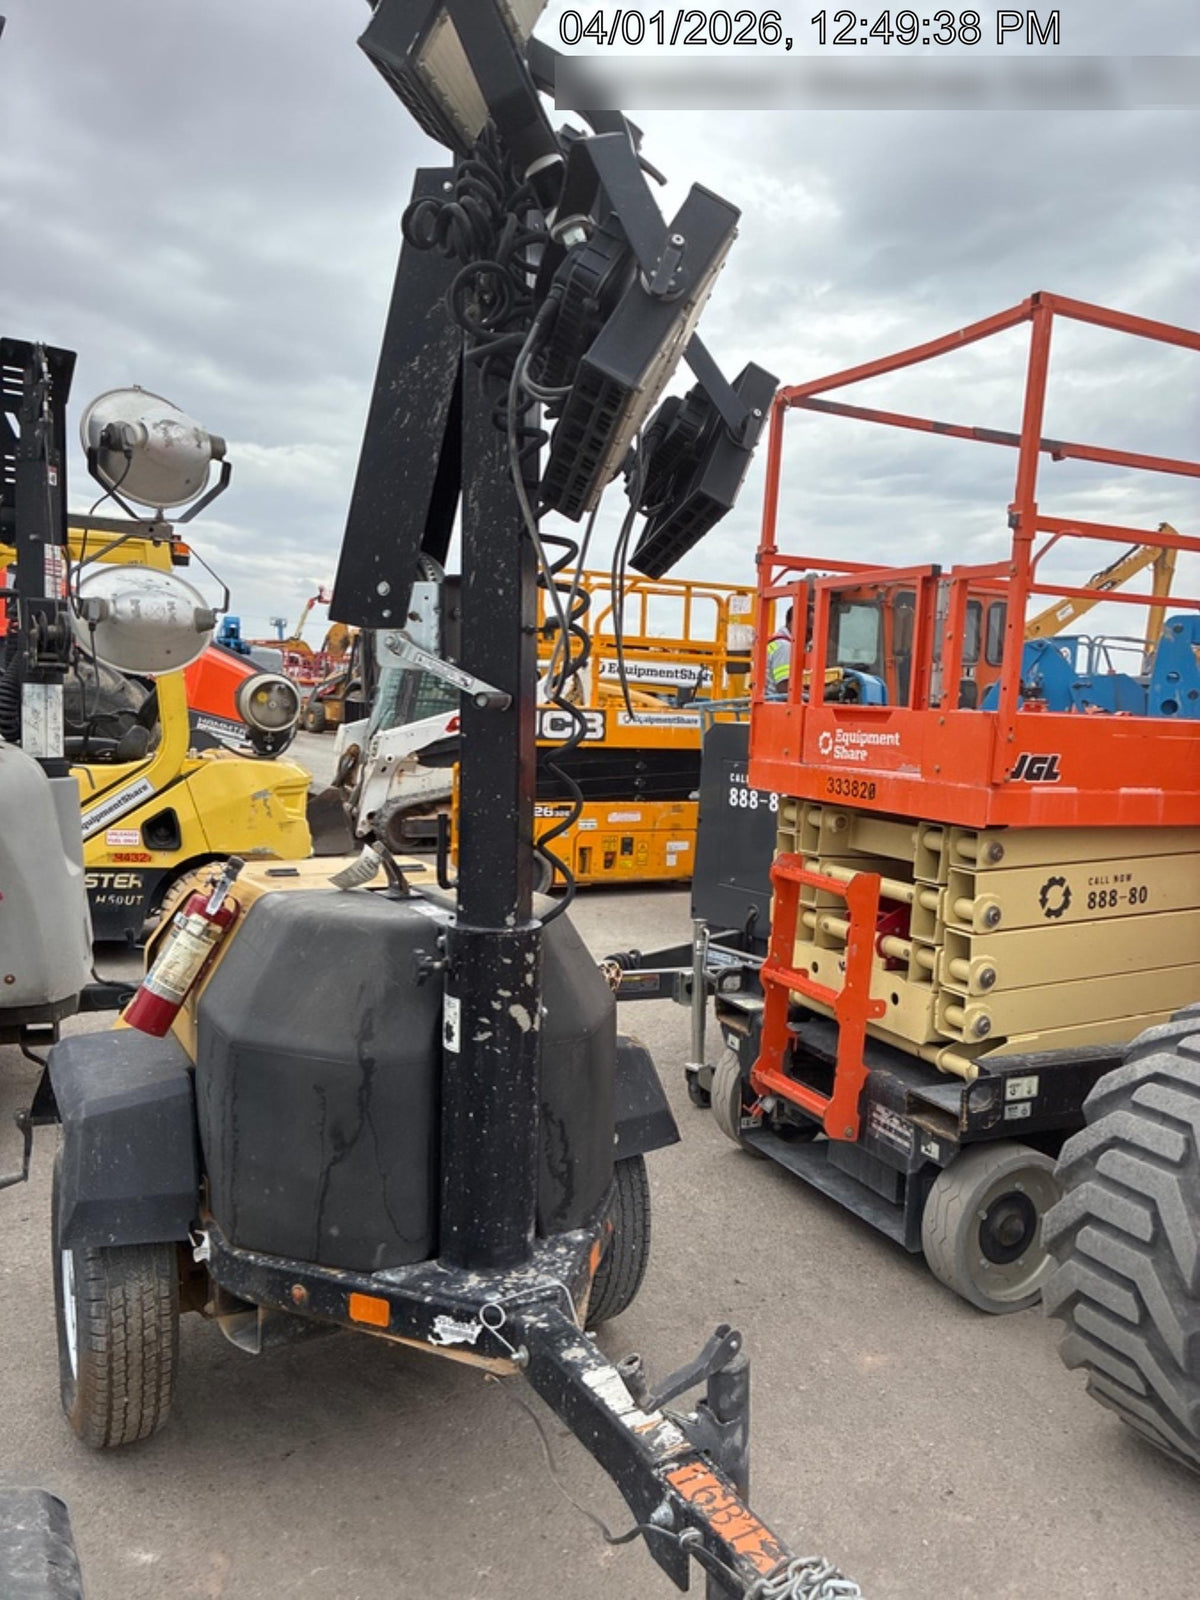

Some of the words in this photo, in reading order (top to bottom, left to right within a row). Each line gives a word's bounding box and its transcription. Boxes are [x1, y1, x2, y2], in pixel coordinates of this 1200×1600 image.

[835, 728, 901, 747] Equipment
[834, 745, 868, 762] Share
[730, 772, 748, 784] CAL
[80, 784, 149, 830] quipmentShare
[729, 787, 788, 812] 888-8
[85, 873, 143, 888] STER
[1088, 876, 1109, 886] CALL
[1113, 873, 1133, 883] NOW
[1087, 885, 1148, 909] 888-80
